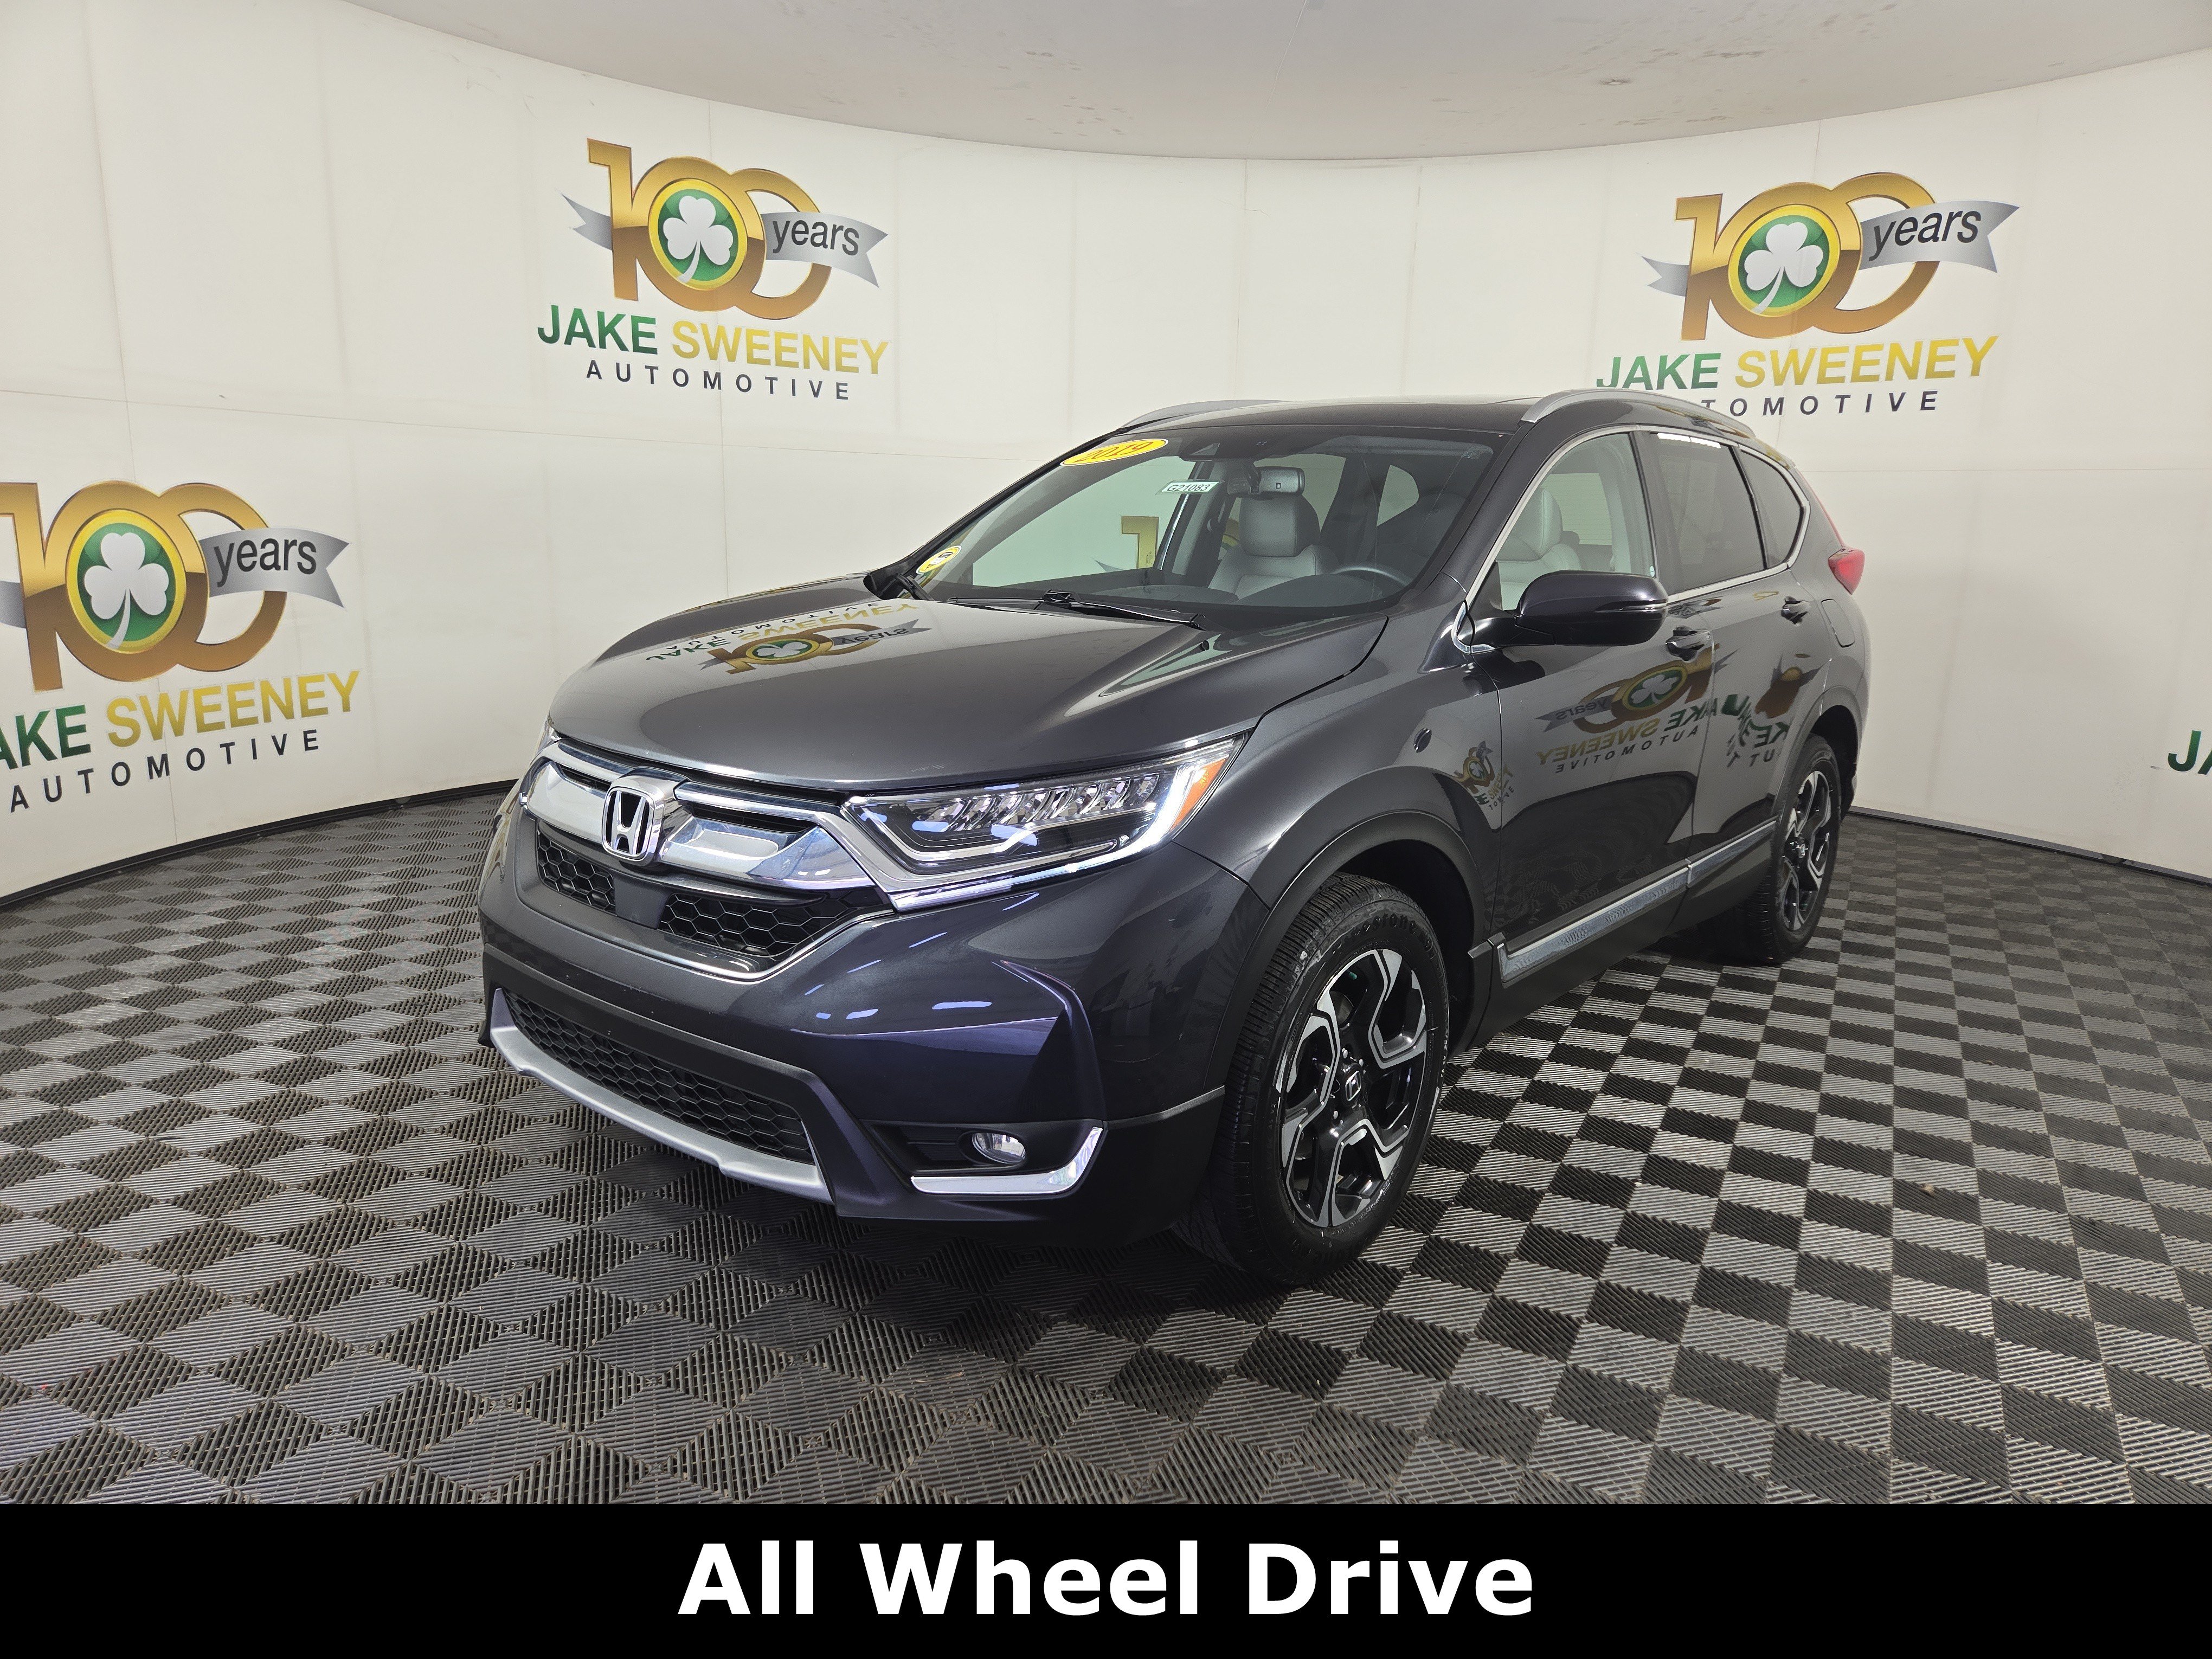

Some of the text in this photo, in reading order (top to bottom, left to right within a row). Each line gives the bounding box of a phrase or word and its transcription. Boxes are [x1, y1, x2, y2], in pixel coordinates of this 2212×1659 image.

[587, 138, 860, 320] 100 years
[1676, 172, 1982, 341] 100 years
[537, 305, 889, 375] JAKE SWEENEY
[1597, 335, 1999, 390] JAKE SWEENEY
[586, 359, 849, 401] AUTOMOTIVE
[1074, 442, 1155, 463] 2019
[213, 538, 318, 586] years
[107, 670, 360, 748] SWEENEY
[10, 729, 319, 813] AUTOMOTIVE
